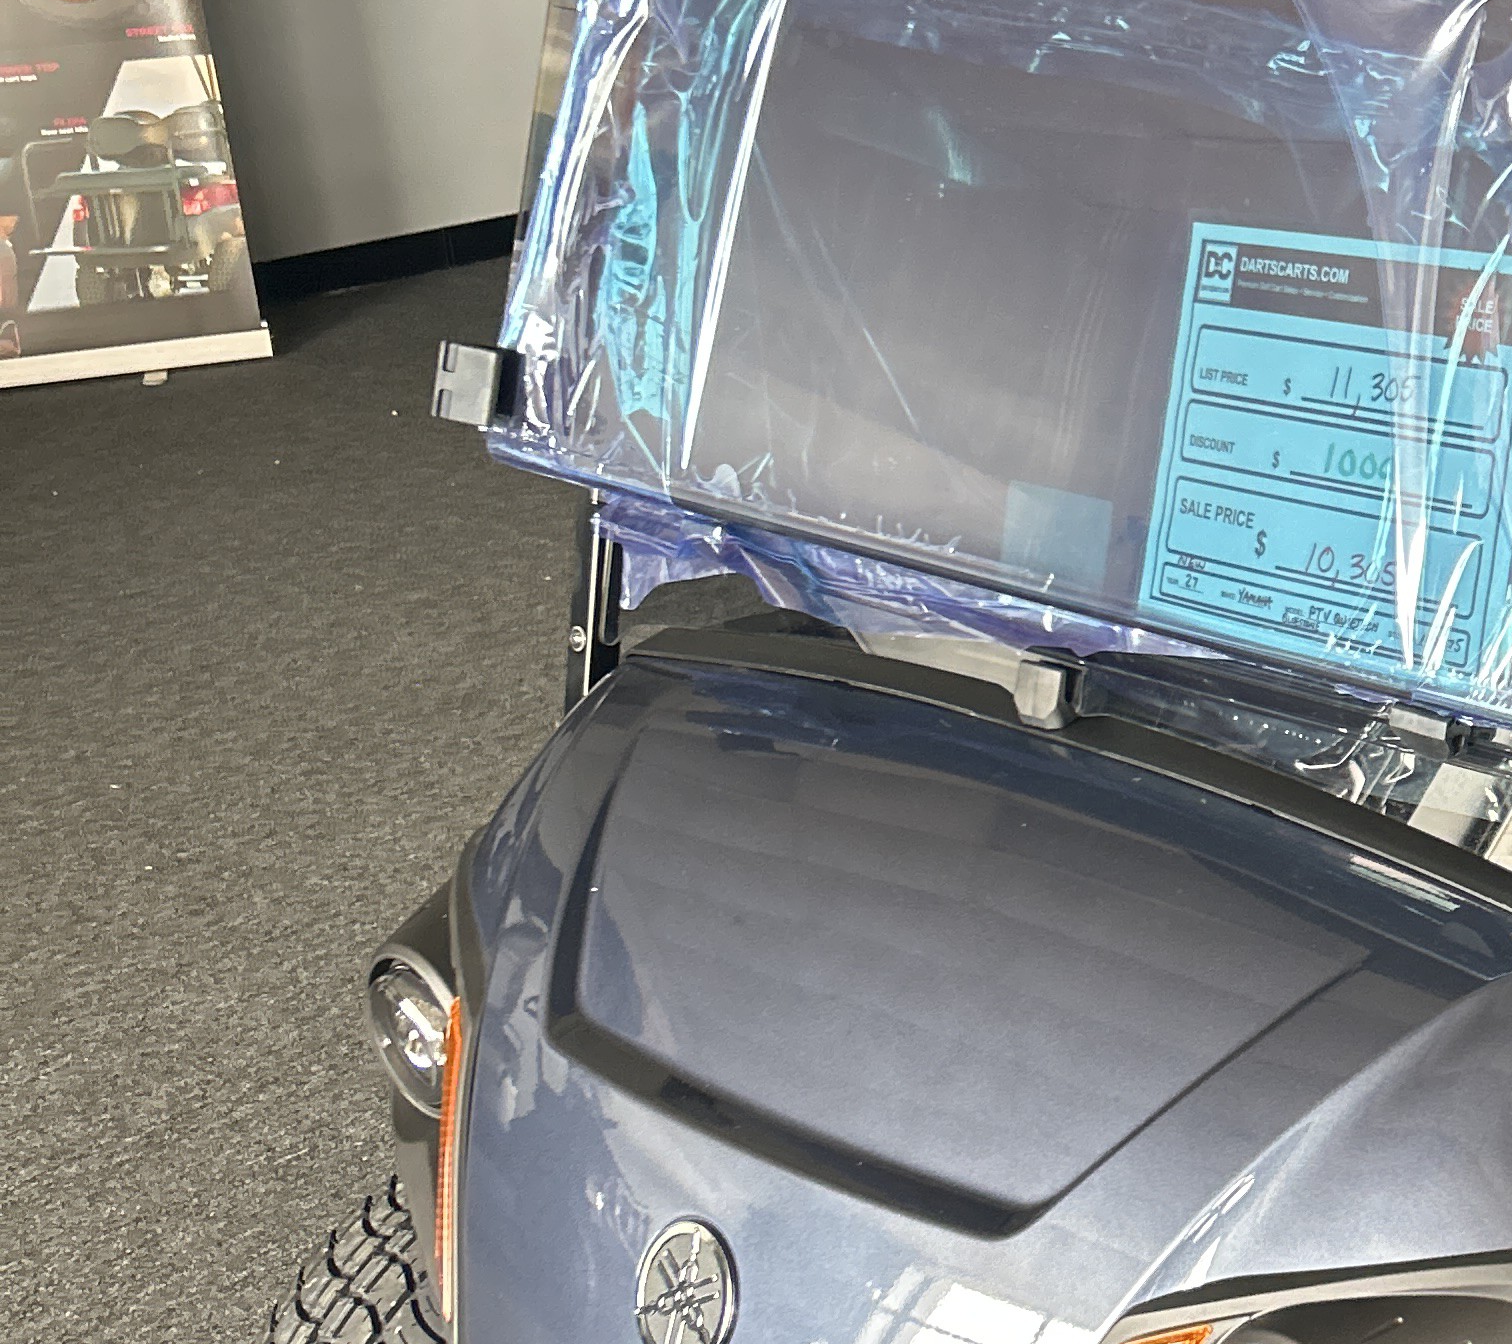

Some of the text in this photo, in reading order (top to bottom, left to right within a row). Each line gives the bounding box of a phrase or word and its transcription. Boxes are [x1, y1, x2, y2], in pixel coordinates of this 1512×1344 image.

[1240, 256, 1350, 285] DARTSCARTS.COM
[1460, 297, 1495, 315] SLE
[1199, 365, 1422, 417] LIST PRICE $ 11,305
[1189, 433, 1236, 454] DISCOUNT
[1271, 450, 1281, 469] $
[1179, 497, 1256, 529] SALE PRICE
[1255, 529, 1397, 588] $ 10,305
